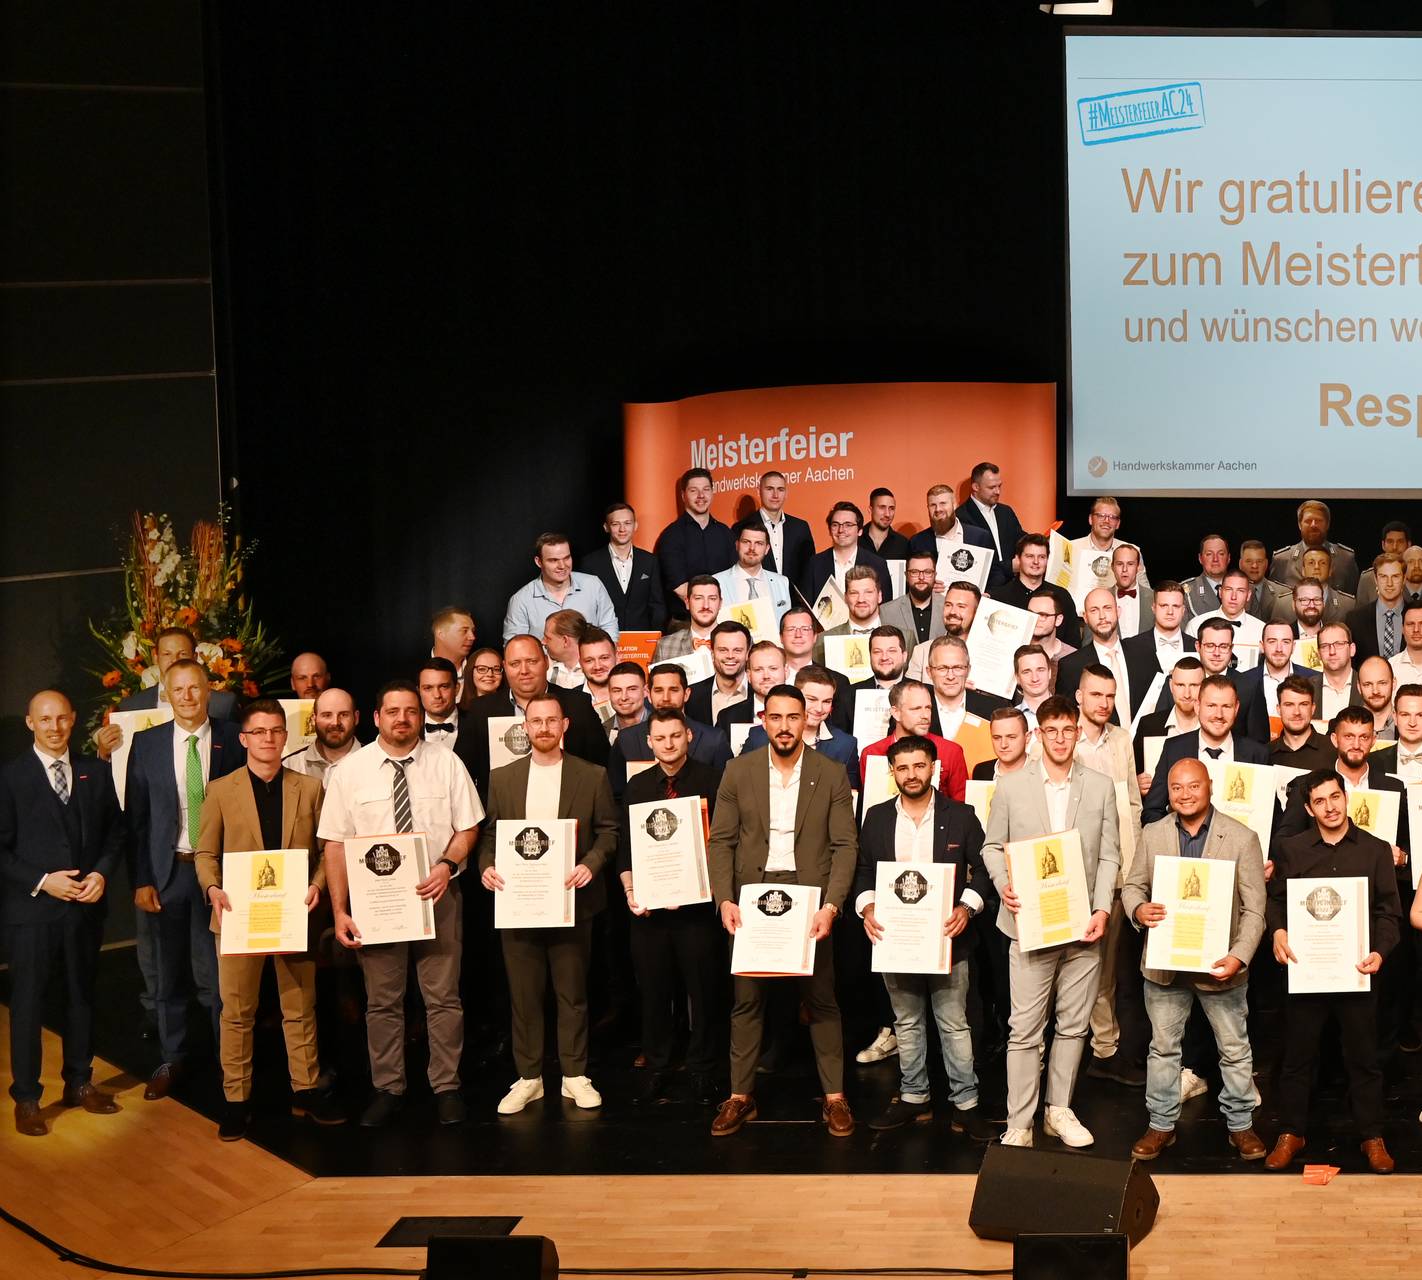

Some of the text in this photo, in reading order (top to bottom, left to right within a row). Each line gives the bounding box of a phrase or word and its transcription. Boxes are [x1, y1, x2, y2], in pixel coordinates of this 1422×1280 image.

[1122, 167, 1205, 215] Wir
[1123, 251, 1223, 288] zum
[1125, 308, 1190, 343] und
[1201, 309, 1377, 343] wünschen
[691, 426, 853, 471] Meisterfeier
[1112, 460, 1257, 471] Handwerkskammer Aachen
[805, 466, 854, 483] Aachen
